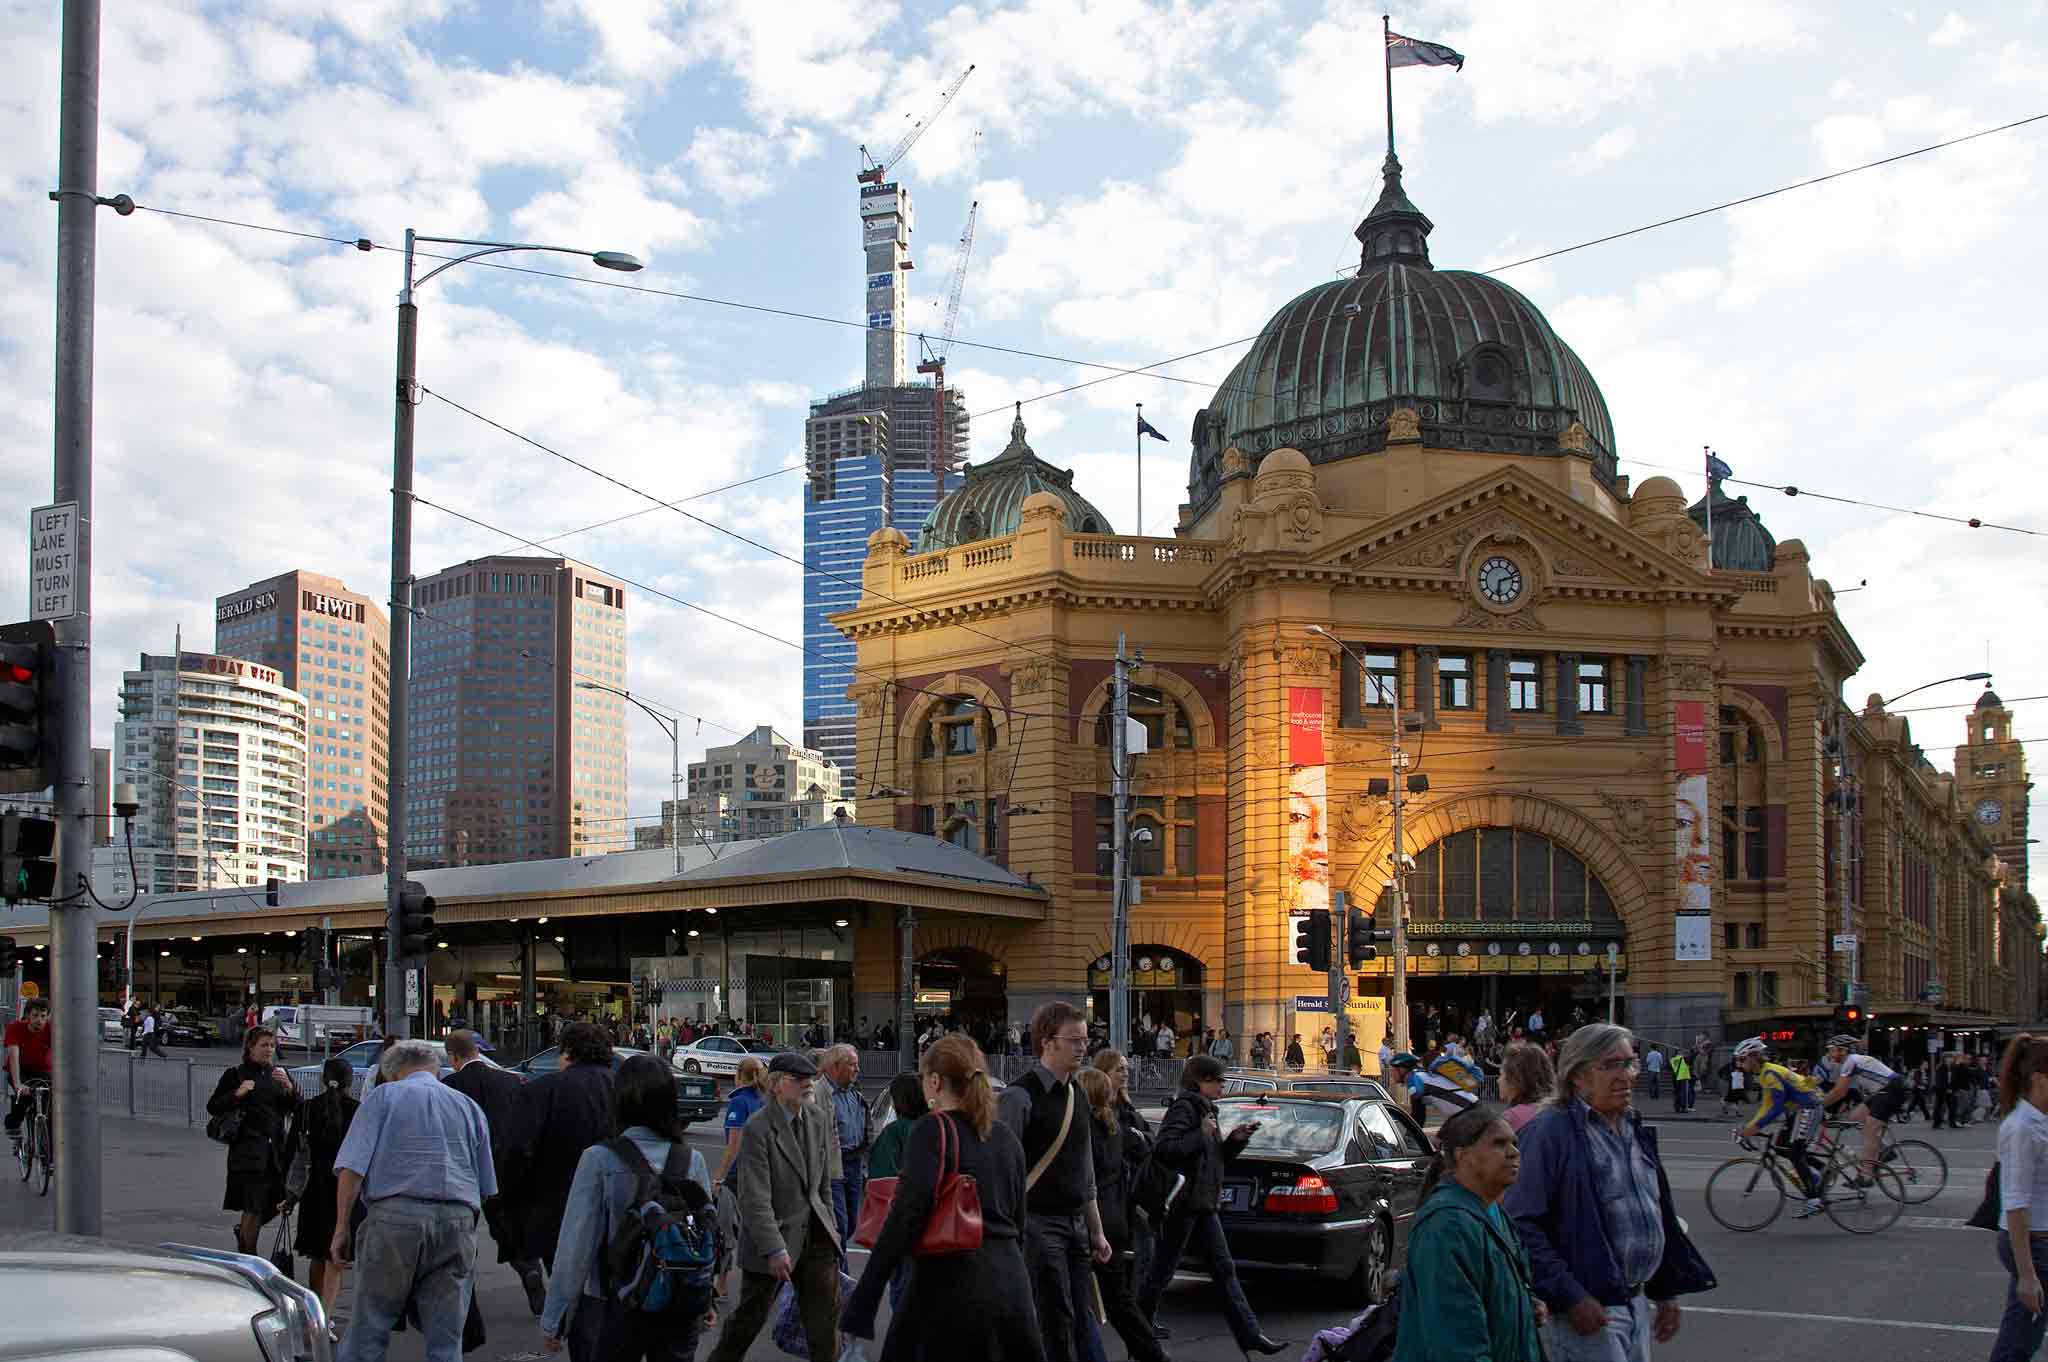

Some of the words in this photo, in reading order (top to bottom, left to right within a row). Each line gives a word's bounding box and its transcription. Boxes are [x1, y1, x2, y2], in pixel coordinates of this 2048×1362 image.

[39, 513, 71, 532] LEFT
[33, 533, 65, 552] LANE
[35, 553, 71, 573] MUST
[36, 574, 70, 593] TURN
[38, 594, 68, 613] LEFT
[216, 599, 253, 622] HERALD
[255, 591, 277, 609] SUN
[207, 657, 244, 676] QUAY
[250, 665, 277, 685] WEST
[1407, 923, 1466, 934] FLINDERS
[1480, 923, 1527, 934] STREET
[1537, 923, 1593, 934] STATION
[1297, 1000, 1323, 1008] Herald
[1344, 999, 1381, 1011] Sunday
[706, 1063, 734, 1071] Police
